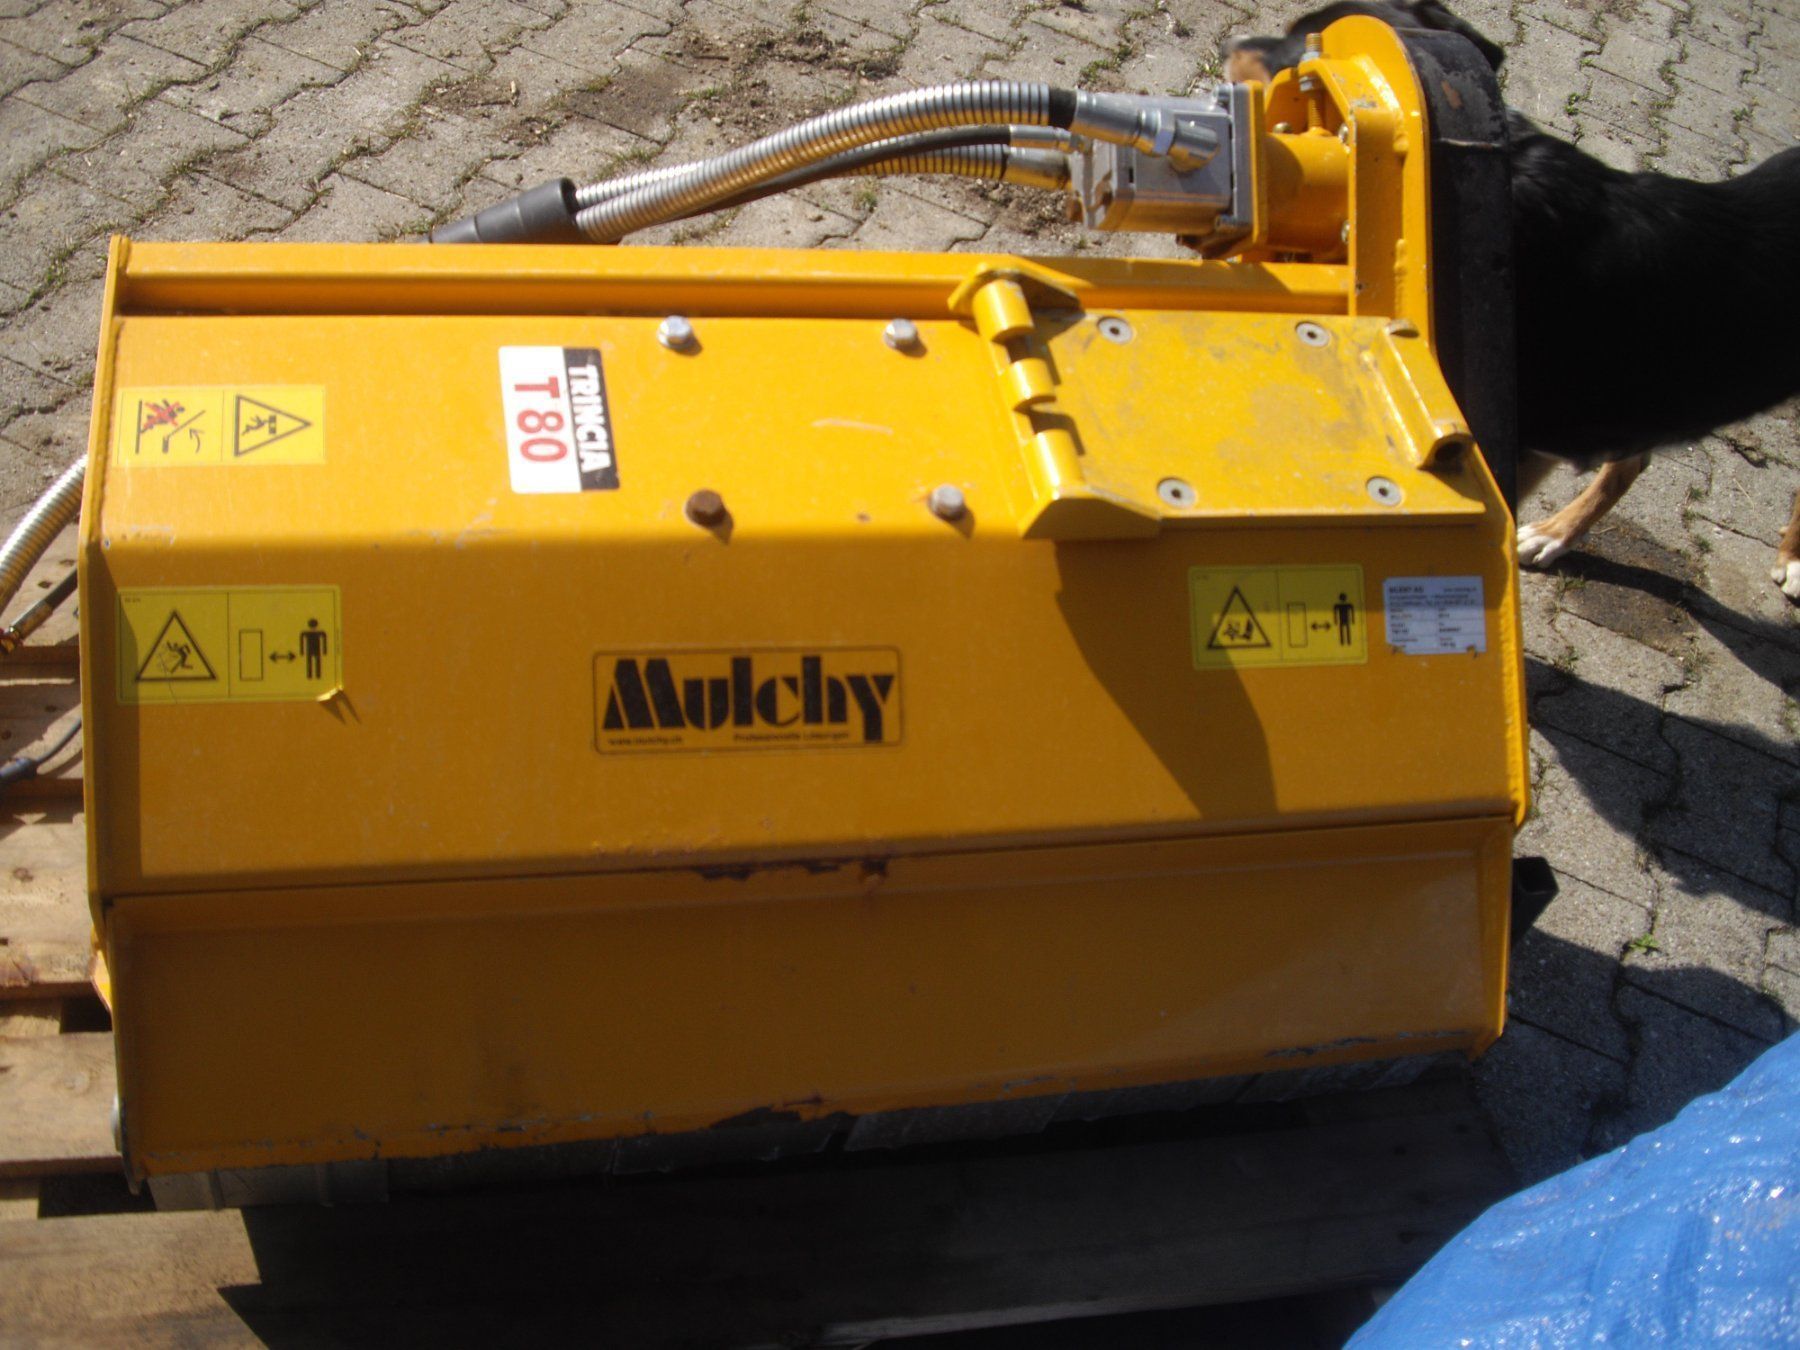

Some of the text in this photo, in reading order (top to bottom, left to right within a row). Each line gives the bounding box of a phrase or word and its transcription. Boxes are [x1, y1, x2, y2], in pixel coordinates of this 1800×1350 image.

[514, 376, 568, 462] T 80
[568, 364, 612, 473] TRINCIA
[602, 655, 895, 743] Mulchy
